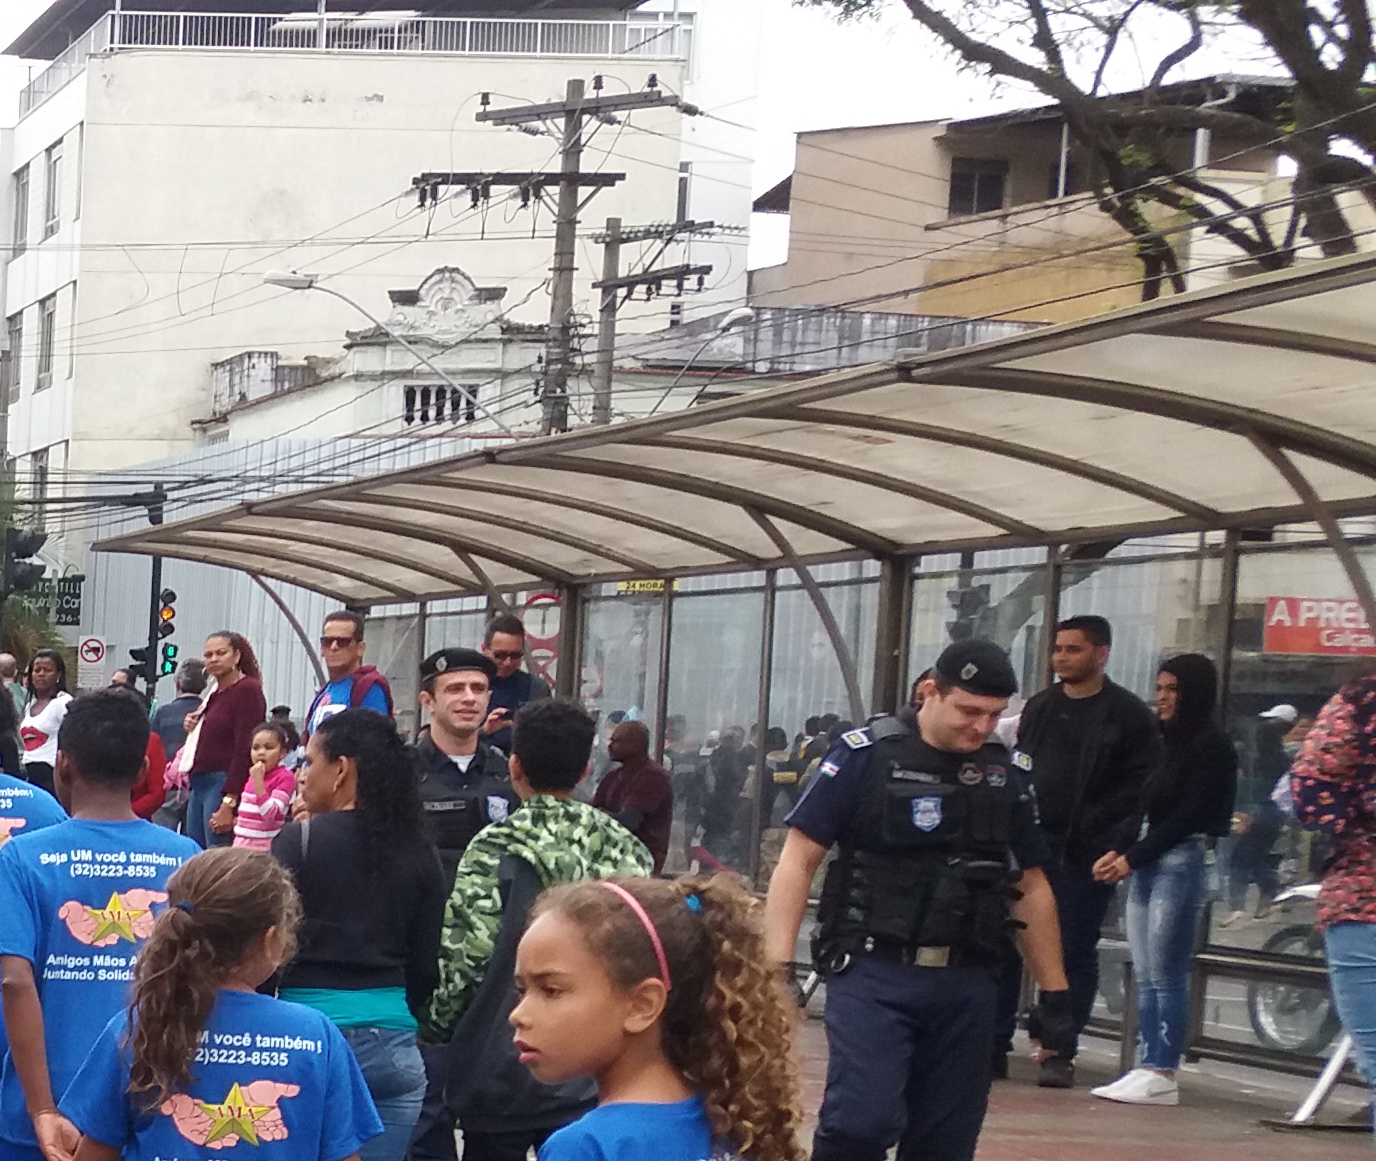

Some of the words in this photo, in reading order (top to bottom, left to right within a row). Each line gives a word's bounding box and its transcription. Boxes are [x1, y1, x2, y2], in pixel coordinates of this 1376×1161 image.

[1268, 600, 1292, 627] A
[39, 852, 68, 866] Seja
[70, 849, 92, 862] UM
[95, 850, 127, 863] você
[129, 851, 177, 867] também
[70, 863, 157, 878] (32)3223-8535
[93, 954, 127, 967] Mãos
[214, 1032, 251, 1048] você
[255, 1033, 316, 1053] também
